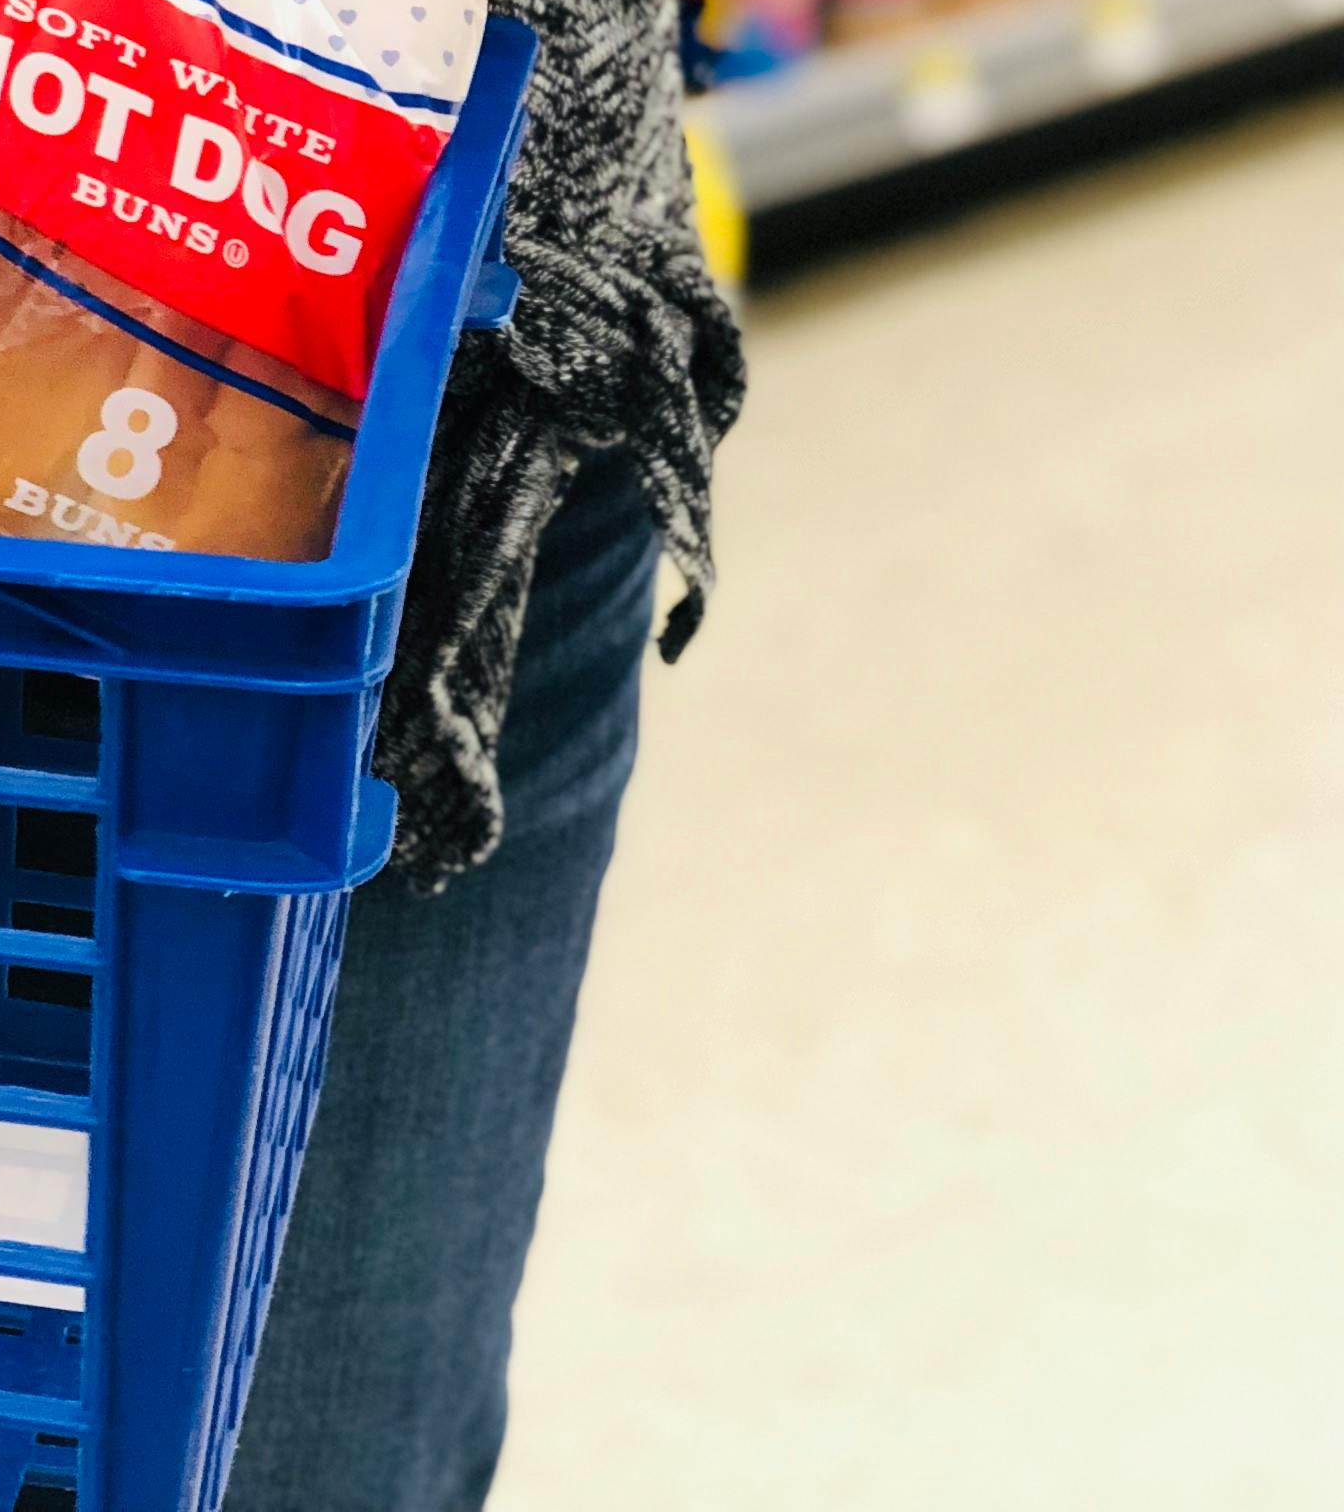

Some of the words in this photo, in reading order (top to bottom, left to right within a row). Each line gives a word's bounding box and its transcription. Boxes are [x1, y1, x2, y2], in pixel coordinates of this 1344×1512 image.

[71, 173, 220, 255] BUNS
[169, 113, 367, 276] DOG
[77, 387, 178, 501] 8
